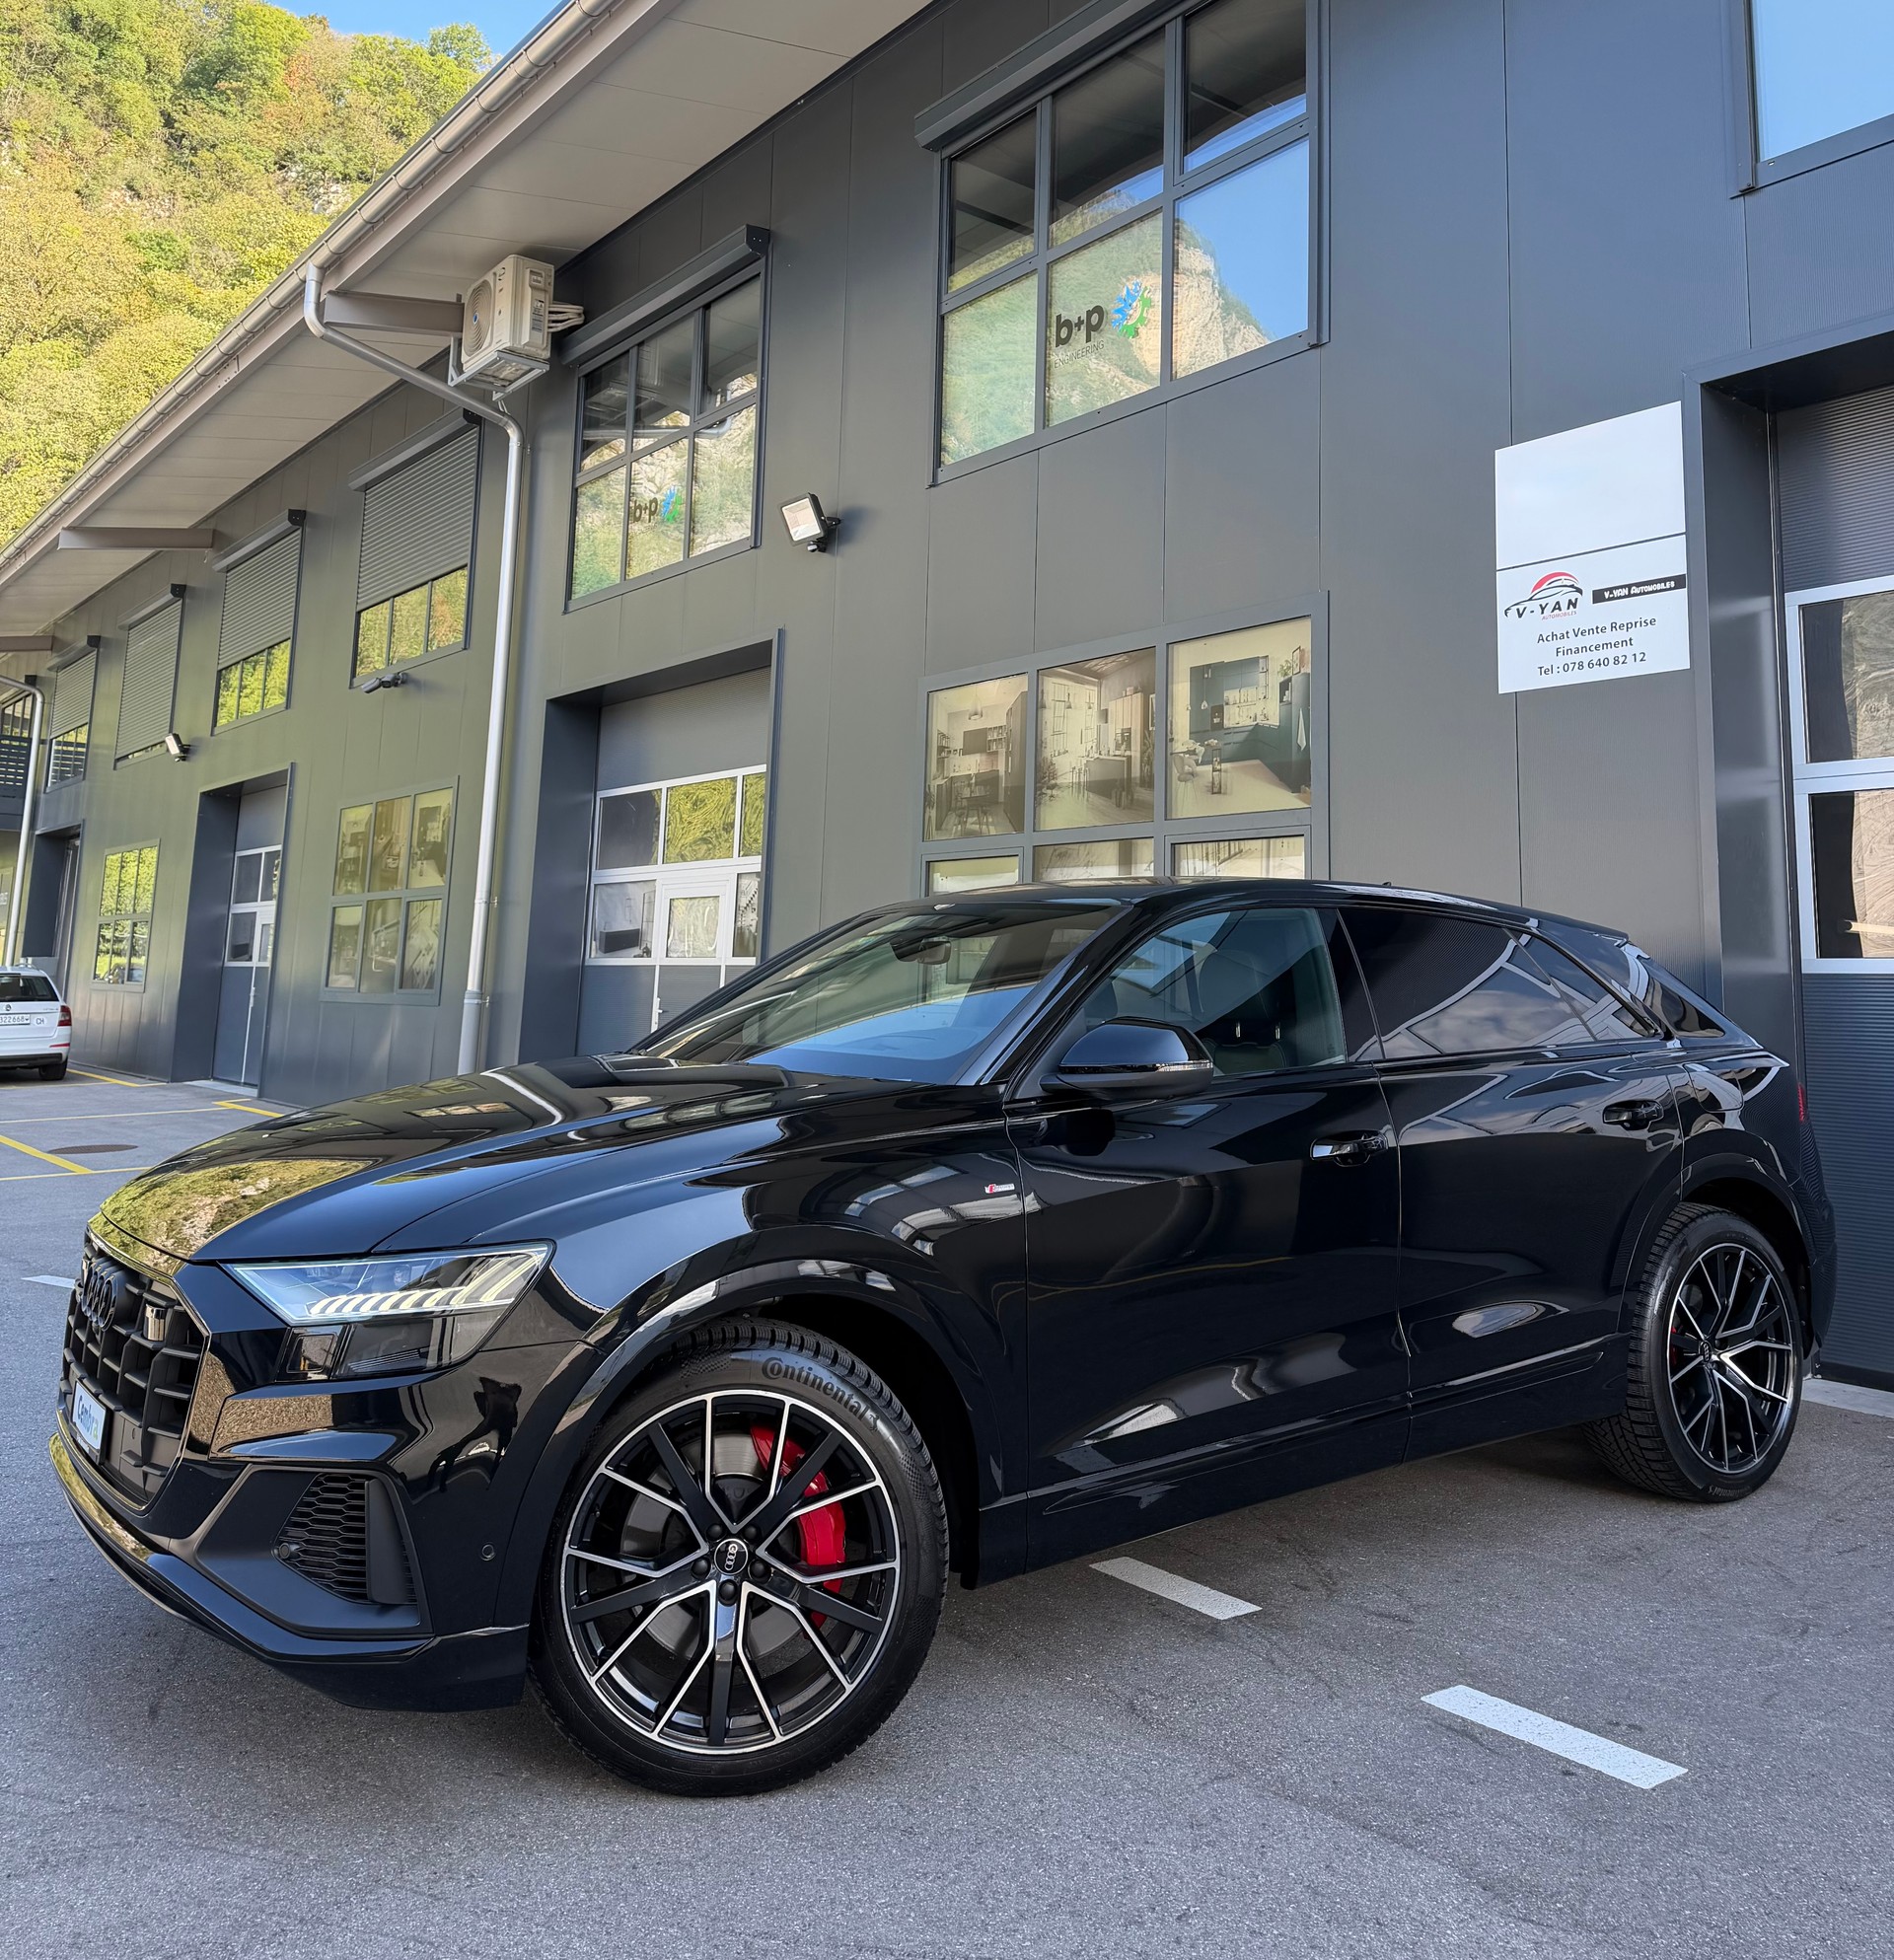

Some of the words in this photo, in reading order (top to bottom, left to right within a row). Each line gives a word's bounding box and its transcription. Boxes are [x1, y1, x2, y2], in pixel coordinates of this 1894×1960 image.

[1055, 305, 1105, 348] b+p
[1054, 339, 1105, 369] ENGINEERING
[633, 497, 658, 523] b+p
[1603, 587, 1629, 600] V-YAN
[1515, 597, 1578, 619] V-YAN
[1541, 611, 1577, 621] AUTOMOBILES
[1537, 630, 1570, 644] Achat
[1571, 624, 1607, 638] Vente
[1609, 617, 1657, 632] Reprise
[1555, 636, 1634, 658] Financement
[1537, 664, 1554, 677] Tel
[1562, 660, 1584, 673] 078
[1586, 656, 1610, 670] 640
[1613, 653, 1628, 666] 82
[1631, 651, 1646, 664] 12
[761, 1356, 871, 1421] Continental
